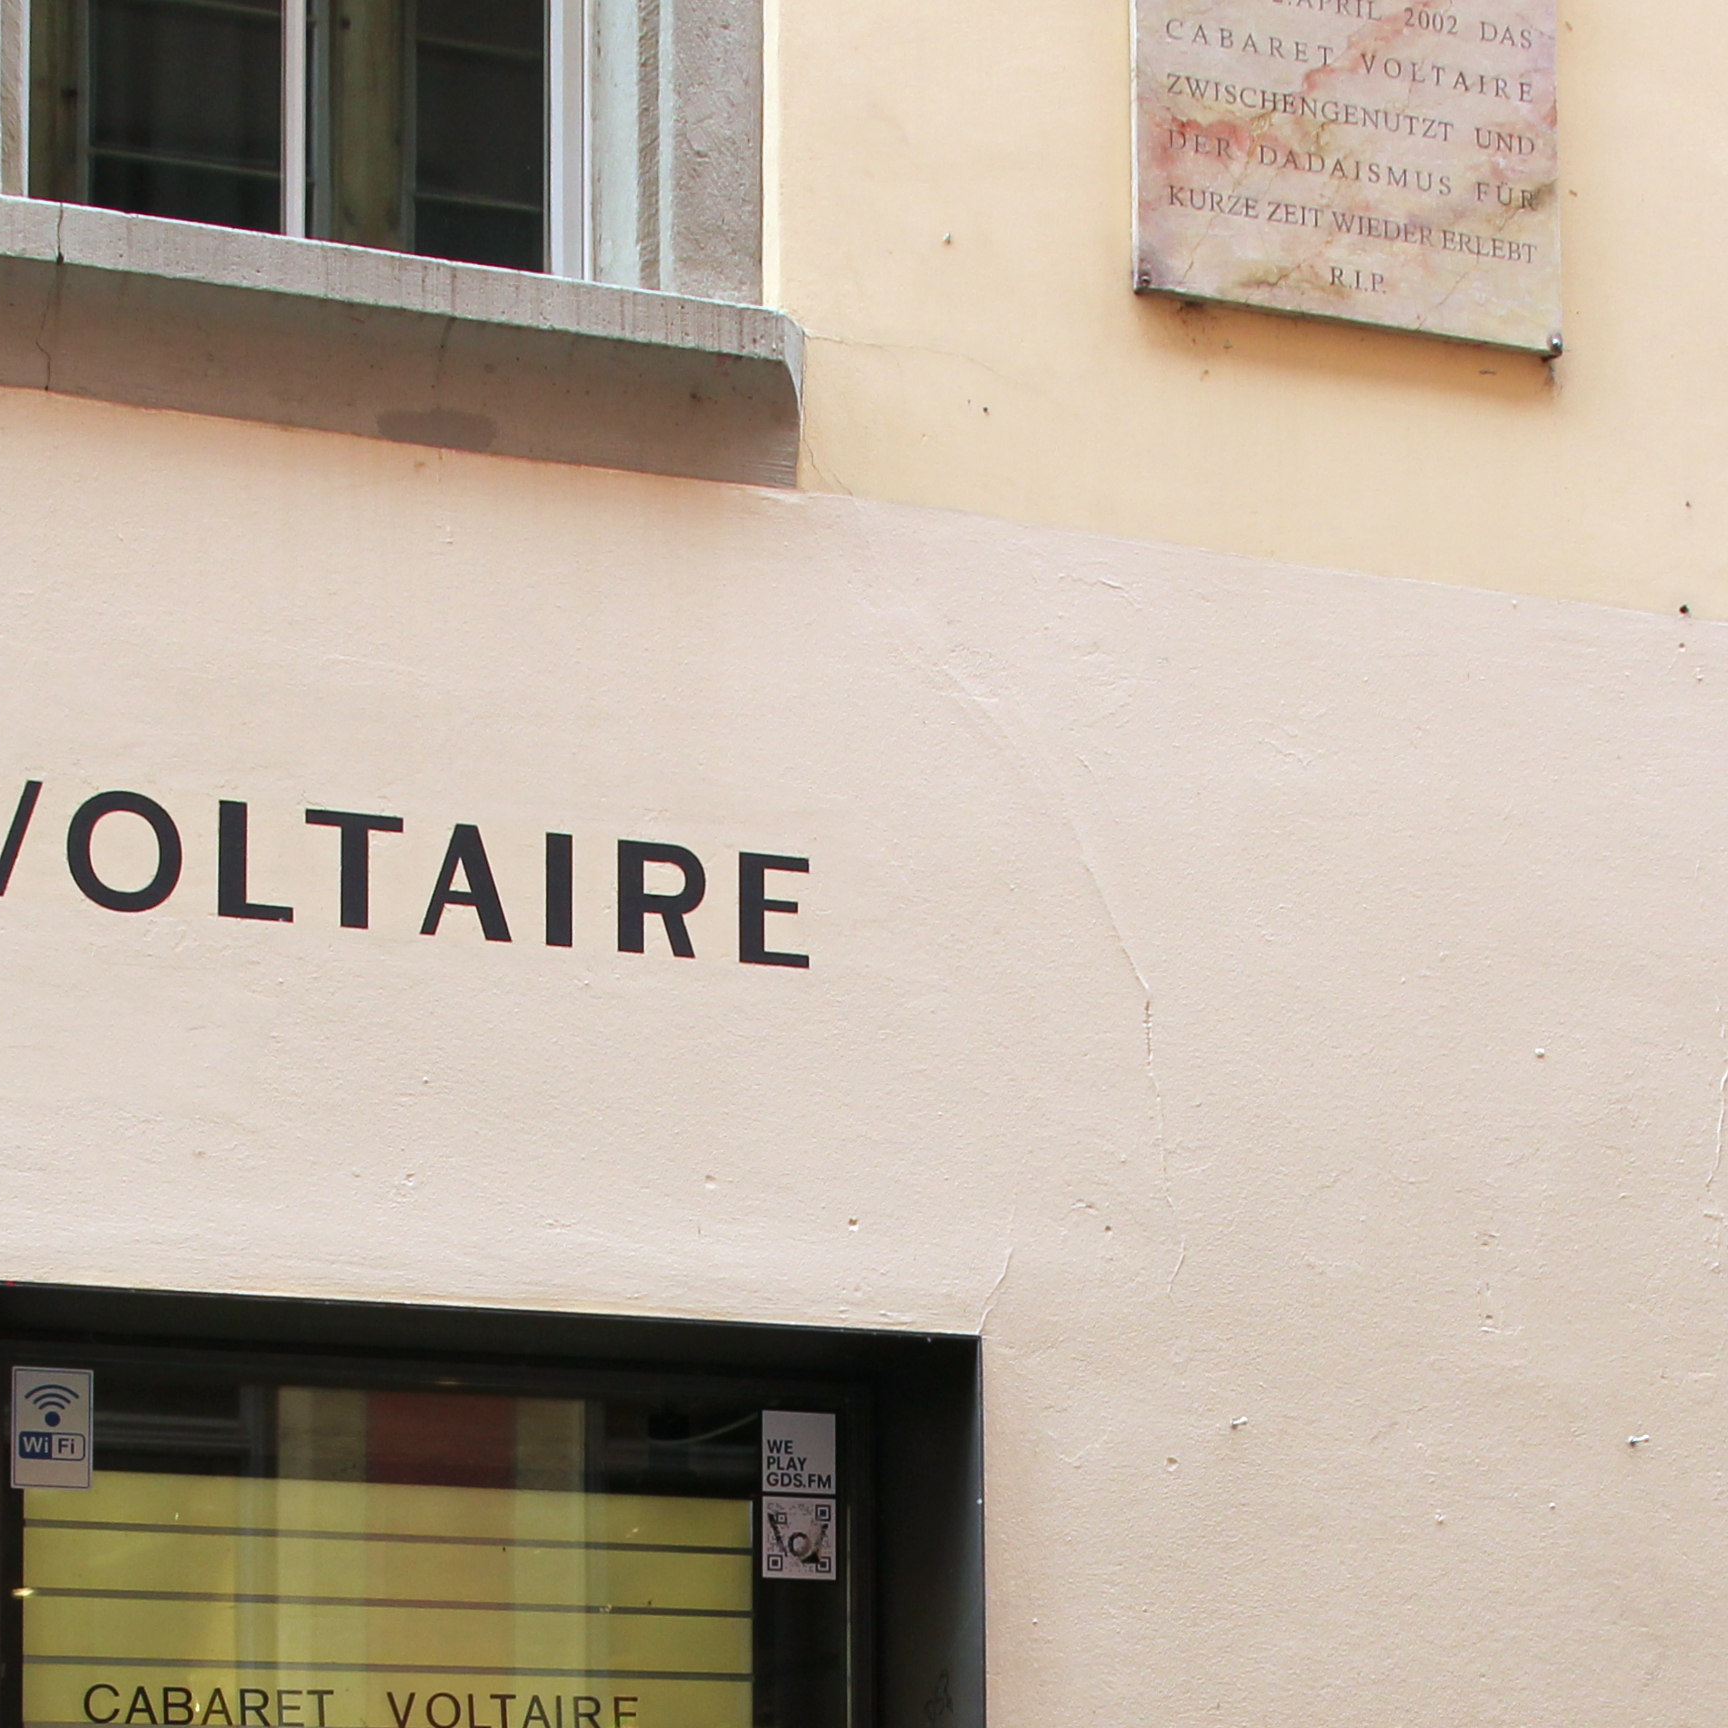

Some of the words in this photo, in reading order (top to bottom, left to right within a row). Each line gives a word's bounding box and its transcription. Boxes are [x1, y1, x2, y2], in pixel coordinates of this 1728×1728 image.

[1403, 7, 1458, 36] 2002
[1479, 21, 1533, 50] DAS
[1165, 19, 1334, 67] CABARET
[1361, 53, 1535, 103] VOLTAIRE
[1165, 72, 1454, 143] ZWISCHENGENUTZT
[1475, 127, 1536, 157] UND
[1169, 129, 1233, 159] DER
[1258, 144, 1452, 197] DADAISMUS
[1476, 179, 1537, 211] FÜR
[1168, 185, 1259, 219] KURZE
[1267, 201, 1324, 229] ZEIT
[1332, 210, 1433, 247] WIEDER
[1442, 229, 1537, 264] ERLEBT
[1330, 266, 1387, 294] R.I.P.
[767, 1439, 793, 1454] WE
[767, 1456, 807, 1472] PLAY
[766, 1472, 832, 1489] GDS.FM
[83, 1683, 334, 1728] CABARET
